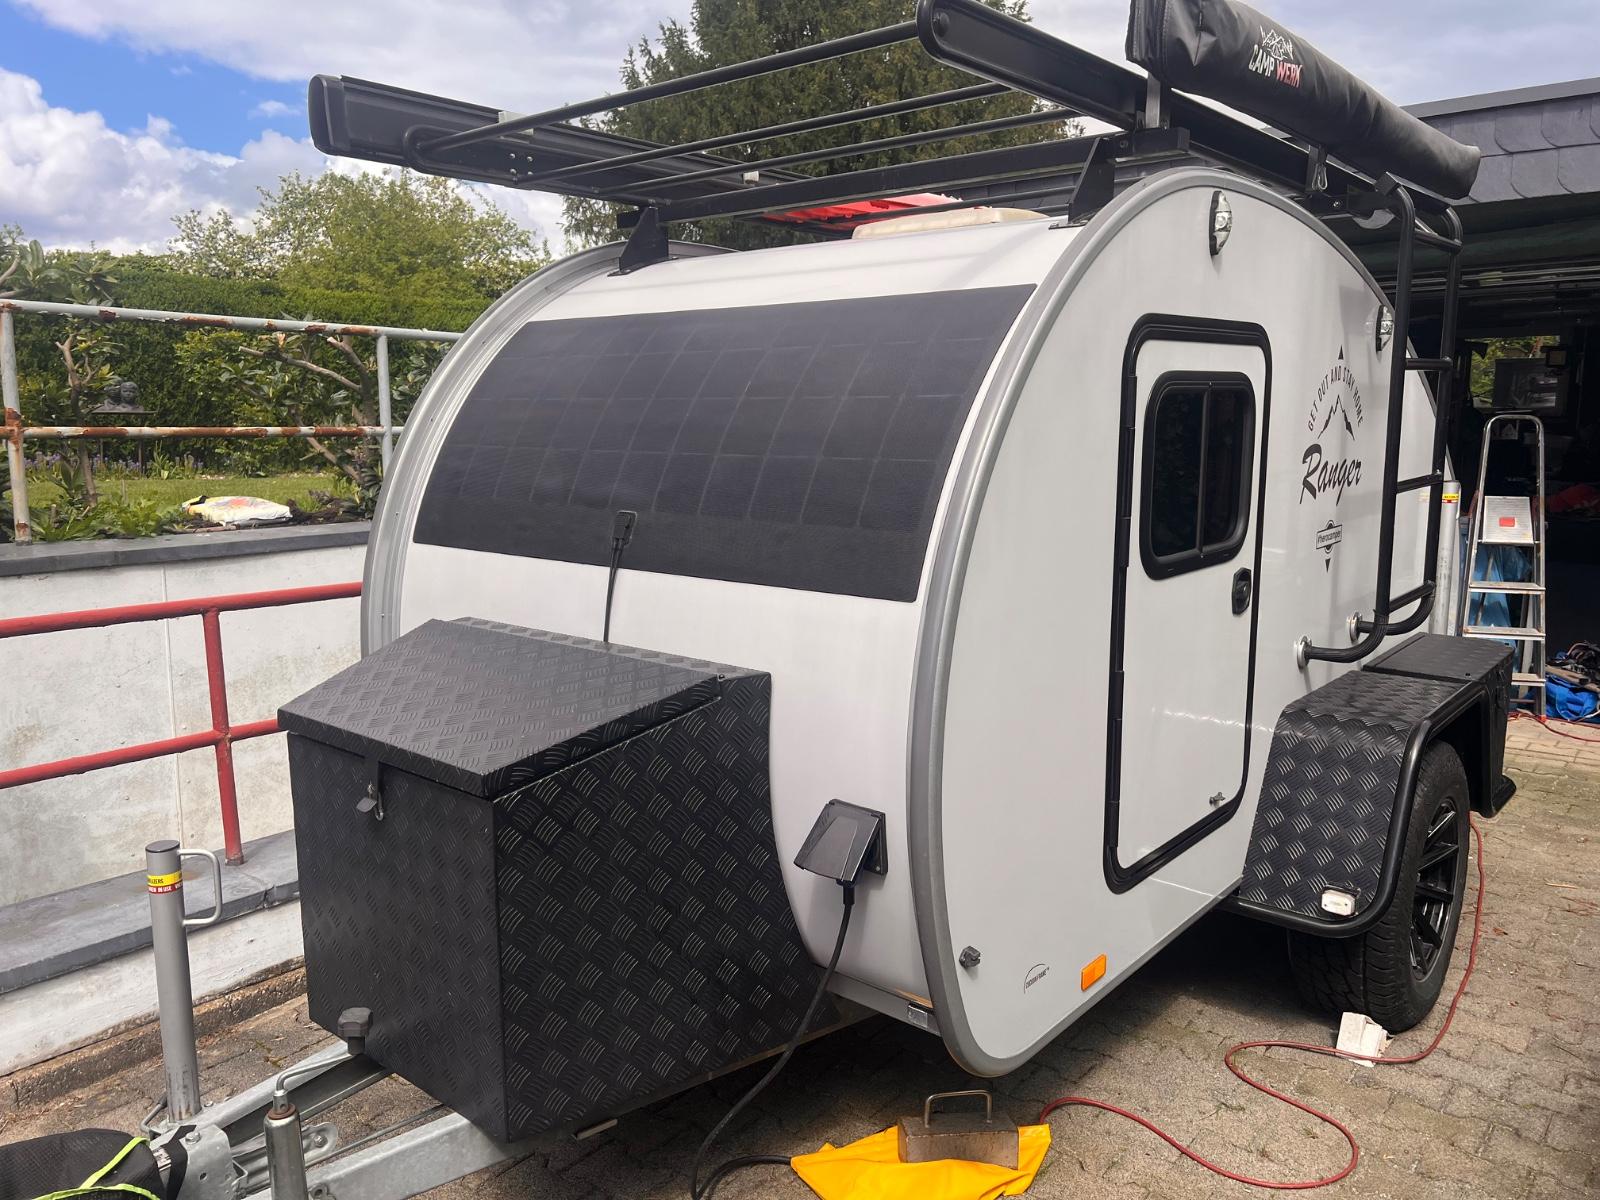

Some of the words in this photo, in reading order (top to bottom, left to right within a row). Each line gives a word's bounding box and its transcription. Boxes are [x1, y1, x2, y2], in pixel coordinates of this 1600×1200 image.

[1248, 44, 1275, 77] CAMP
[1276, 59, 1303, 88] WERK
[1307, 399, 1319, 432] GET
[1317, 374, 1329, 402] OUT
[1330, 365, 1342, 384] AND
[1342, 366, 1356, 391] STAY
[1352, 386, 1364, 428] HOME
[1299, 443, 1362, 506] Ranger
